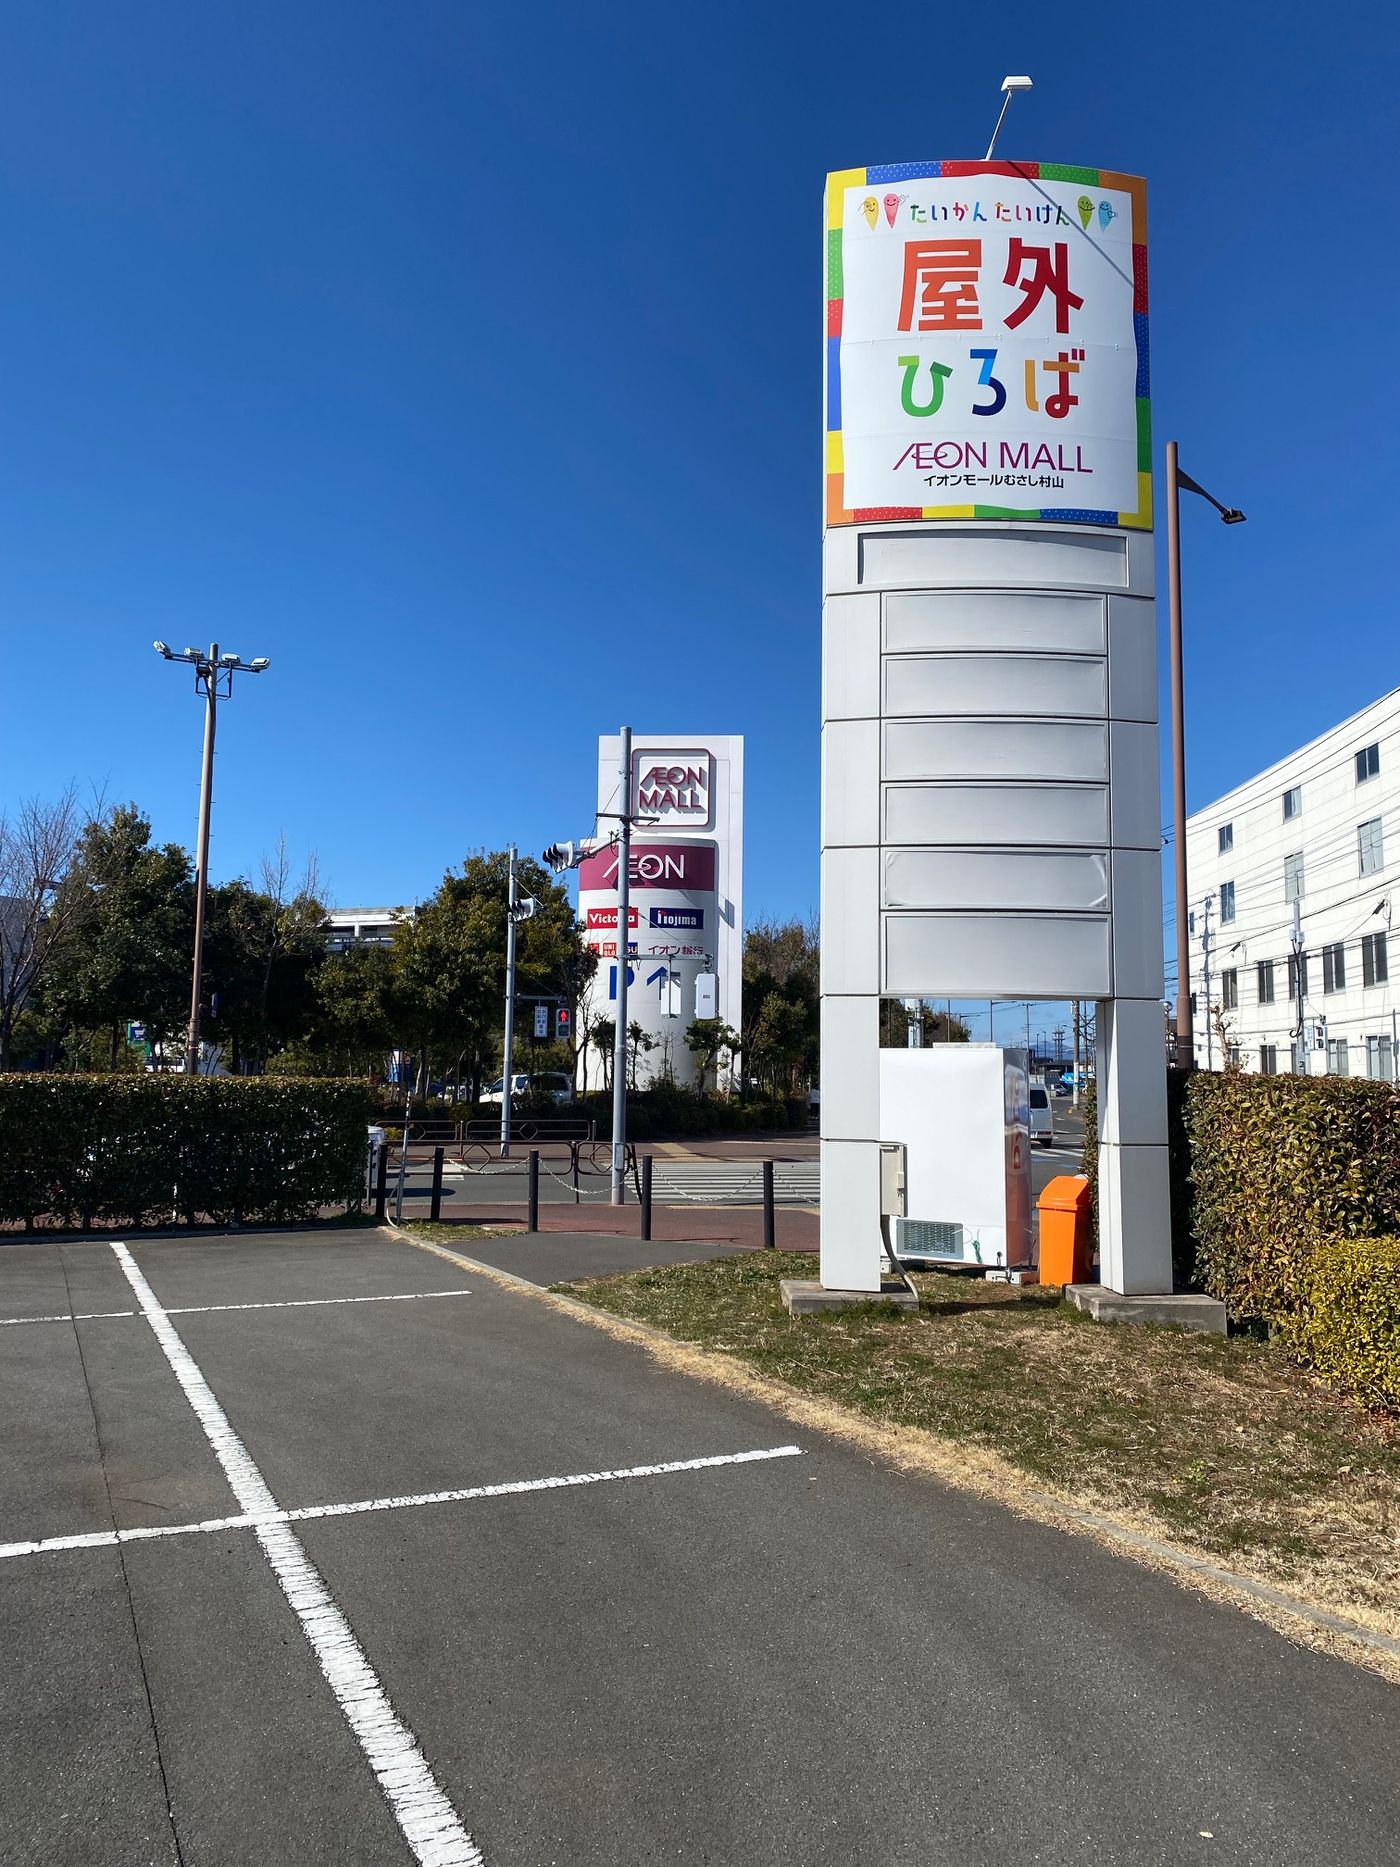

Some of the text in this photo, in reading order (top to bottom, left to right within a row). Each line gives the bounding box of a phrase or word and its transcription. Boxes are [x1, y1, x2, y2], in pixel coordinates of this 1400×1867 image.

[897, 237, 1085, 334] 屋外
[897, 348, 1085, 419] ひろば
[999, 441, 1094, 473] MALL
[923, 474, 1064, 488] イオンモールむさし村山
[639, 789, 702, 808] MALL
[589, 912, 635, 924] Victoa
